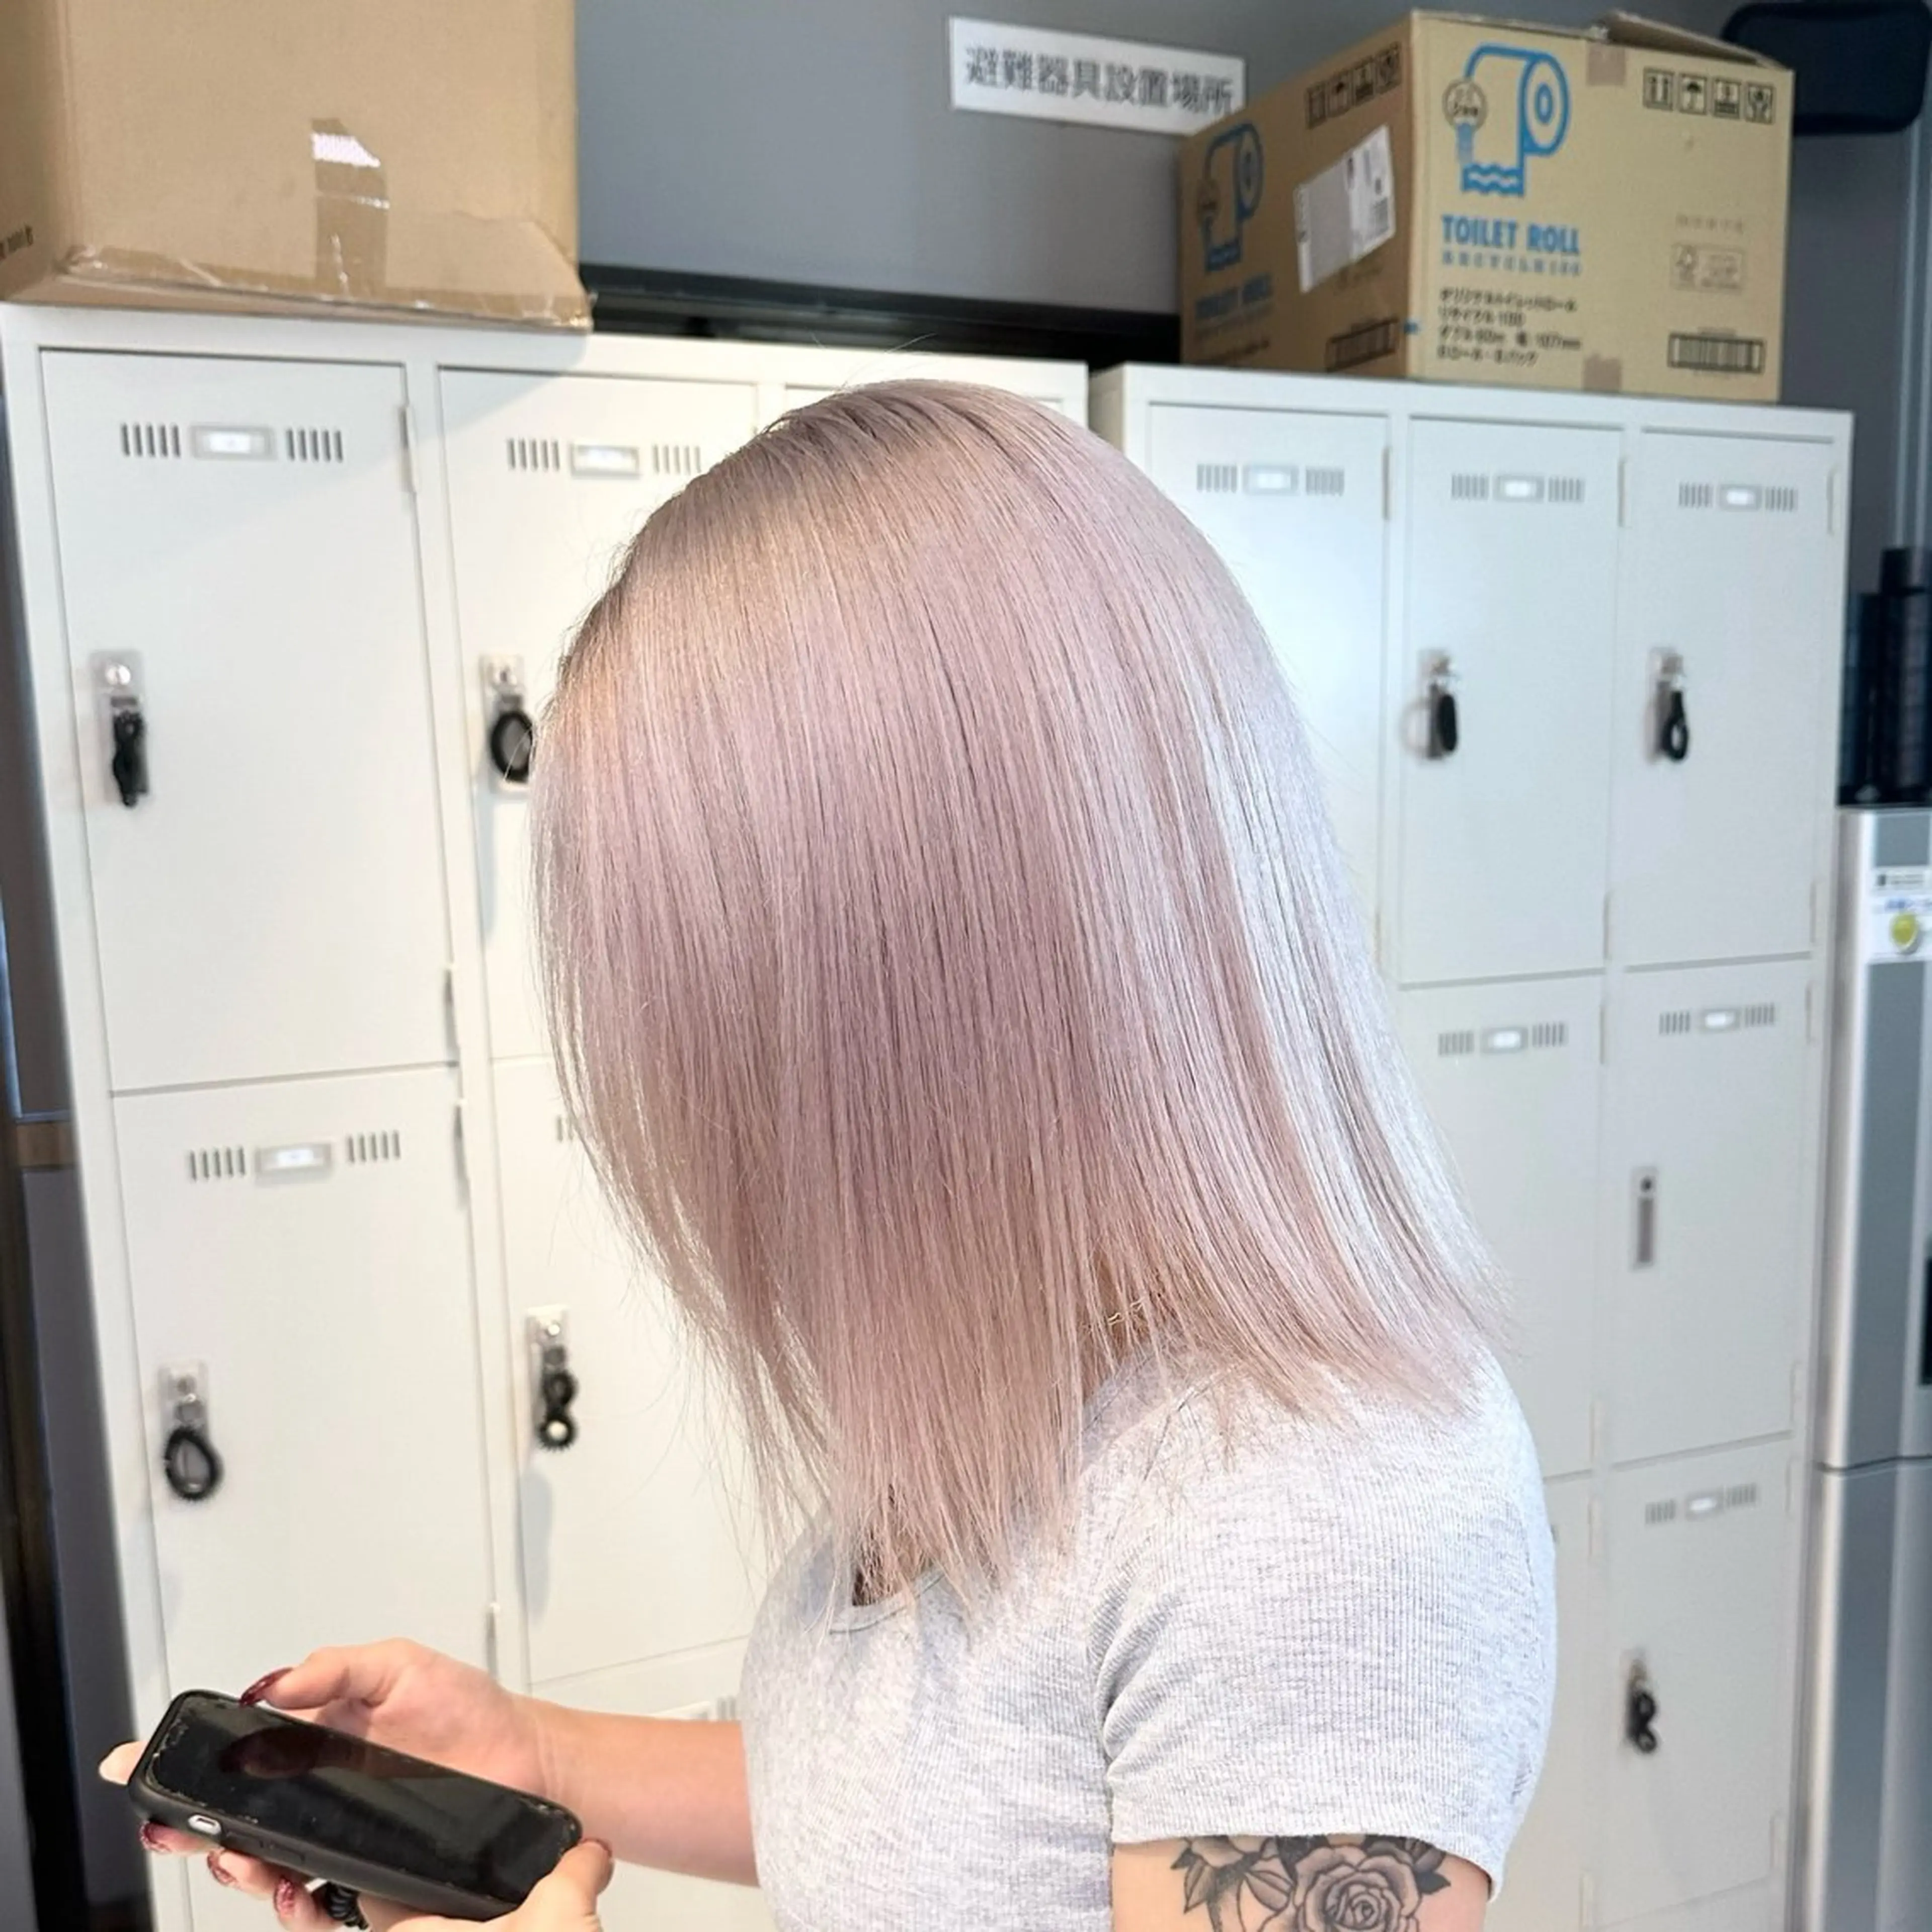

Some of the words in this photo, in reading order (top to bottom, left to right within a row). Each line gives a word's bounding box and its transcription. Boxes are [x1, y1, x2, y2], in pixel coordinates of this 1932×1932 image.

[965, 46, 1234, 114] 避難器具設置場所
[1441, 215, 1517, 249] TOILET
[1526, 223, 1579, 254] ROLL
